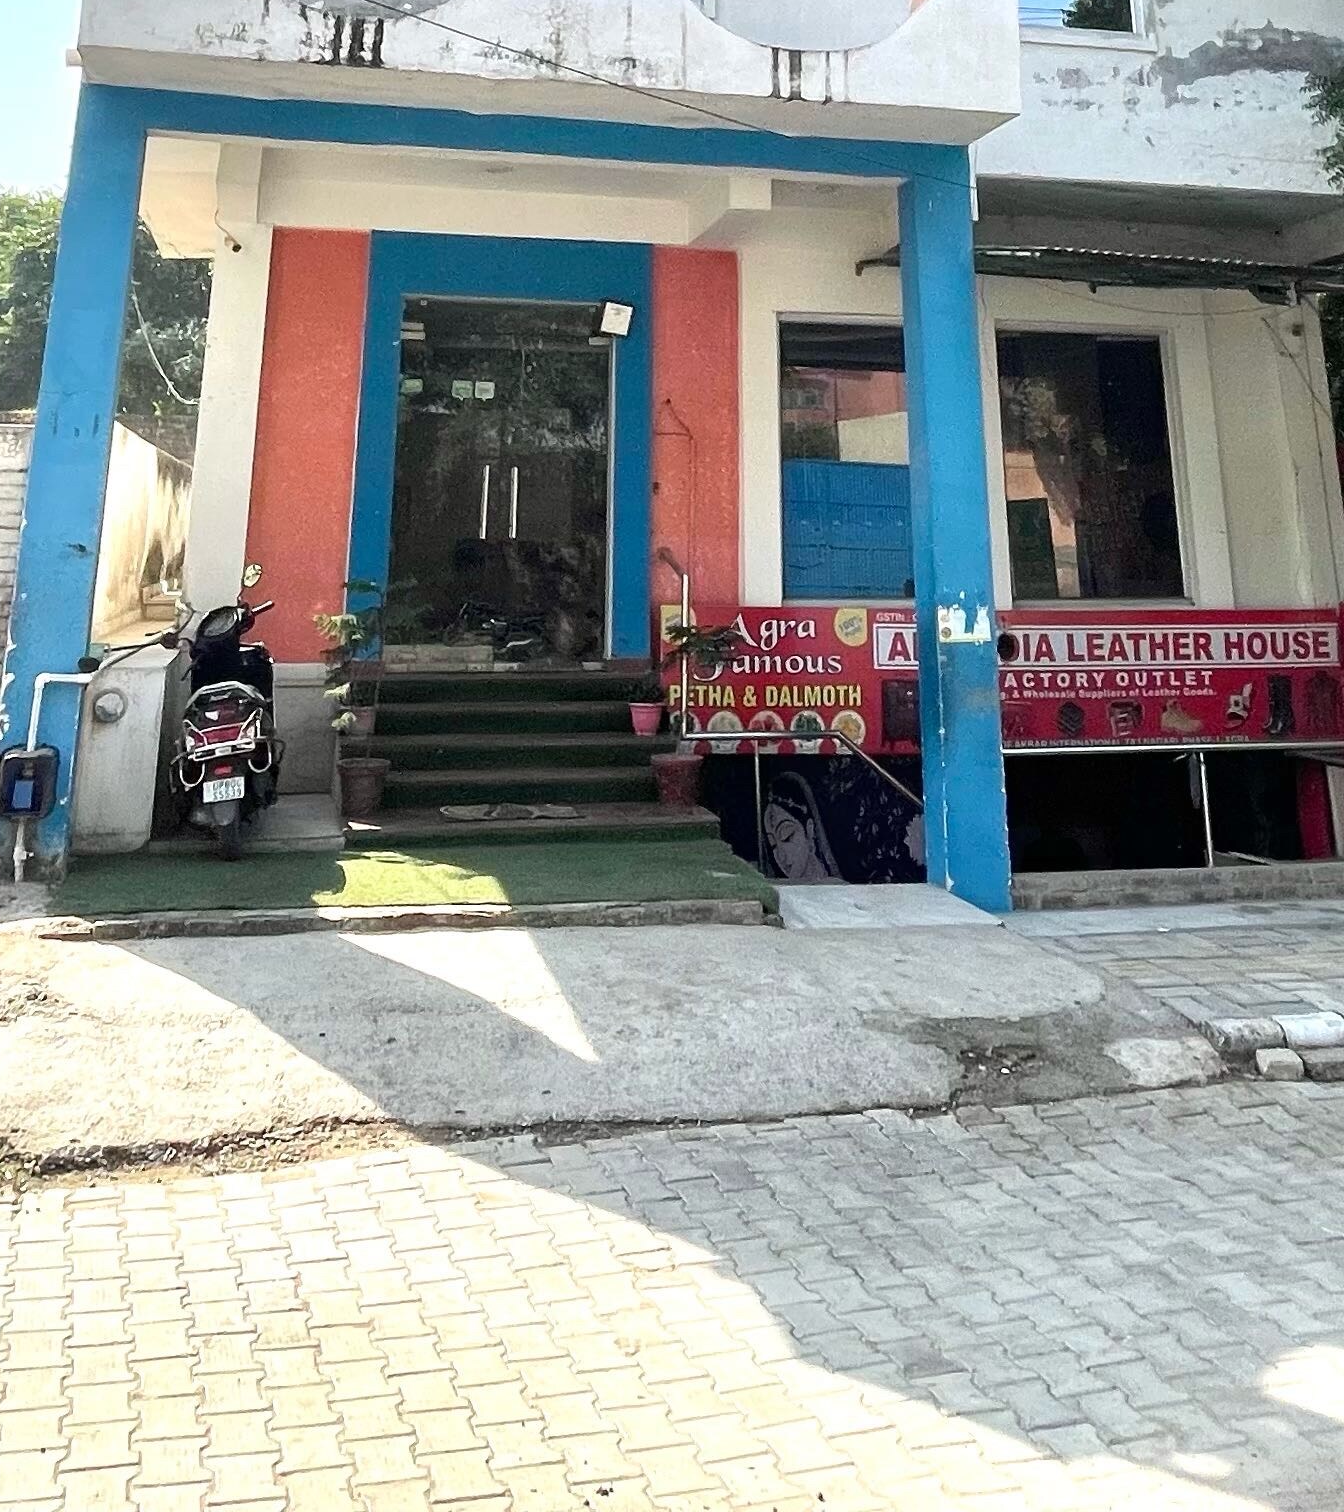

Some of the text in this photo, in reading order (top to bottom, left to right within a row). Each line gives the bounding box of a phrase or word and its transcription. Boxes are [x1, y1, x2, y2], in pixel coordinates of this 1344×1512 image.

[1066, 631, 1214, 663] LEATHER
[1223, 630, 1332, 661] HOUSE
[693, 653, 842, 681] amous
[1004, 670, 1214, 688] ACTORY OUTLET
[743, 685, 758, 707] &
[766, 684, 862, 707] DALMOTH
